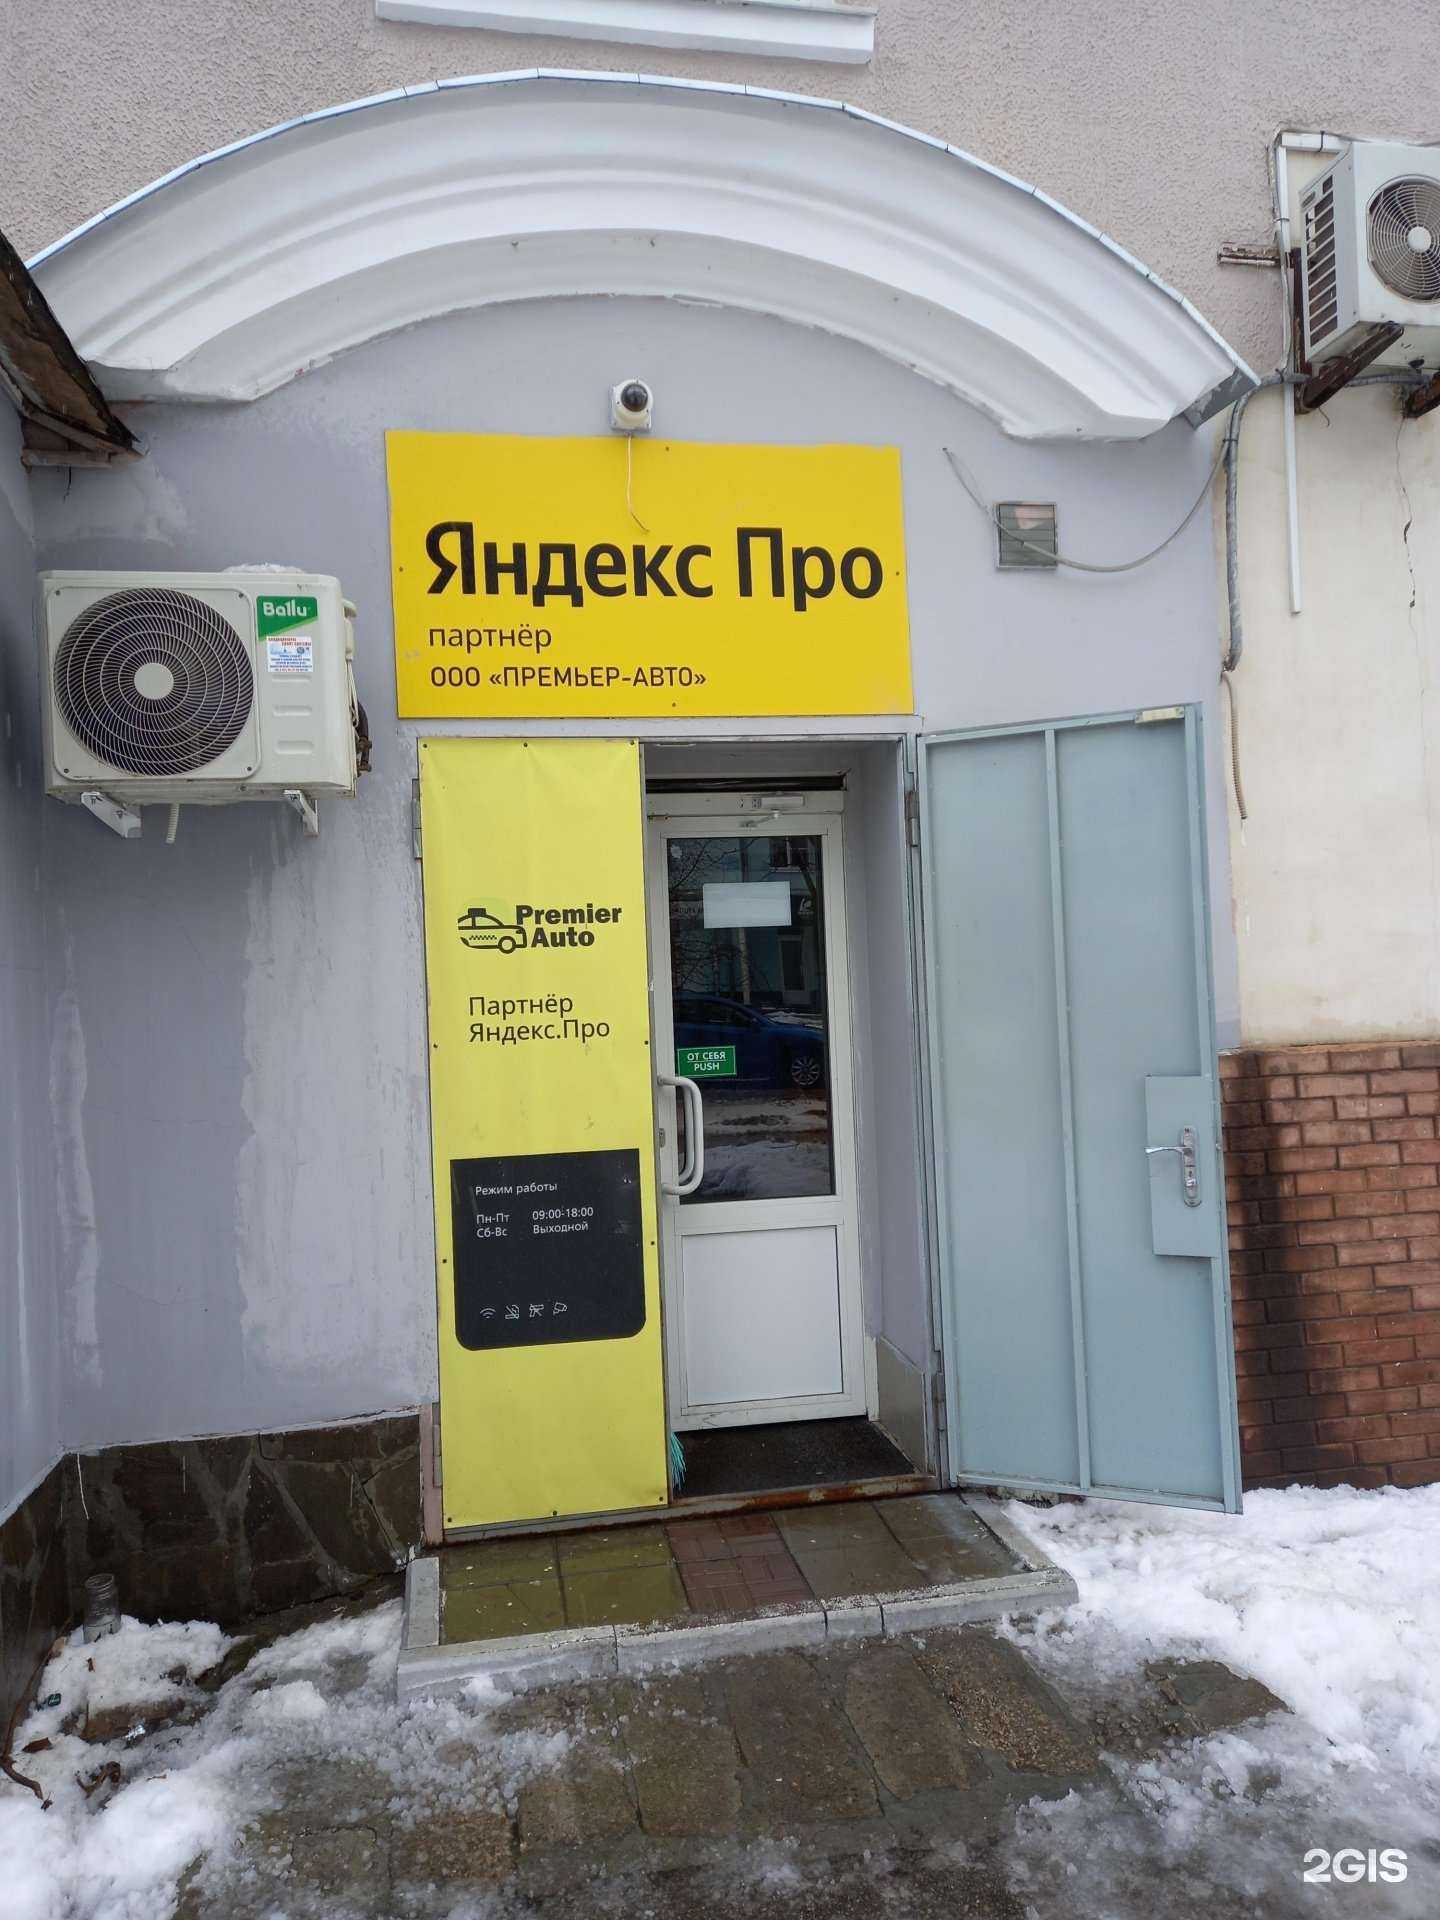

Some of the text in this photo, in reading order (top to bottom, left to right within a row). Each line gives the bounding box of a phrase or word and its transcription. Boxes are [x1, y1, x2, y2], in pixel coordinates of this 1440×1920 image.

[424, 520, 884, 612] Яндекс Про
[262, 599, 308, 617] Ballu
[429, 624, 552, 653] партнёр
[430, 666, 707, 687] ООО «ПРЕМЬЕР-АВТО»
[516, 903, 622, 925] Premier
[531, 927, 595, 948] Auto
[469, 993, 573, 1020] Партнёр
[469, 1019, 610, 1045] Яндекс.Про
[687, 1051, 726, 1061] ОТ СЕБЯ
[694, 1062, 720, 1071] PUSH
[475, 1182, 558, 1196] Режим работы
[476, 1206, 594, 1225] Пн-Пт 09:00-18:00
[476, 1220, 589, 1238] Сб-Вс Выходной
